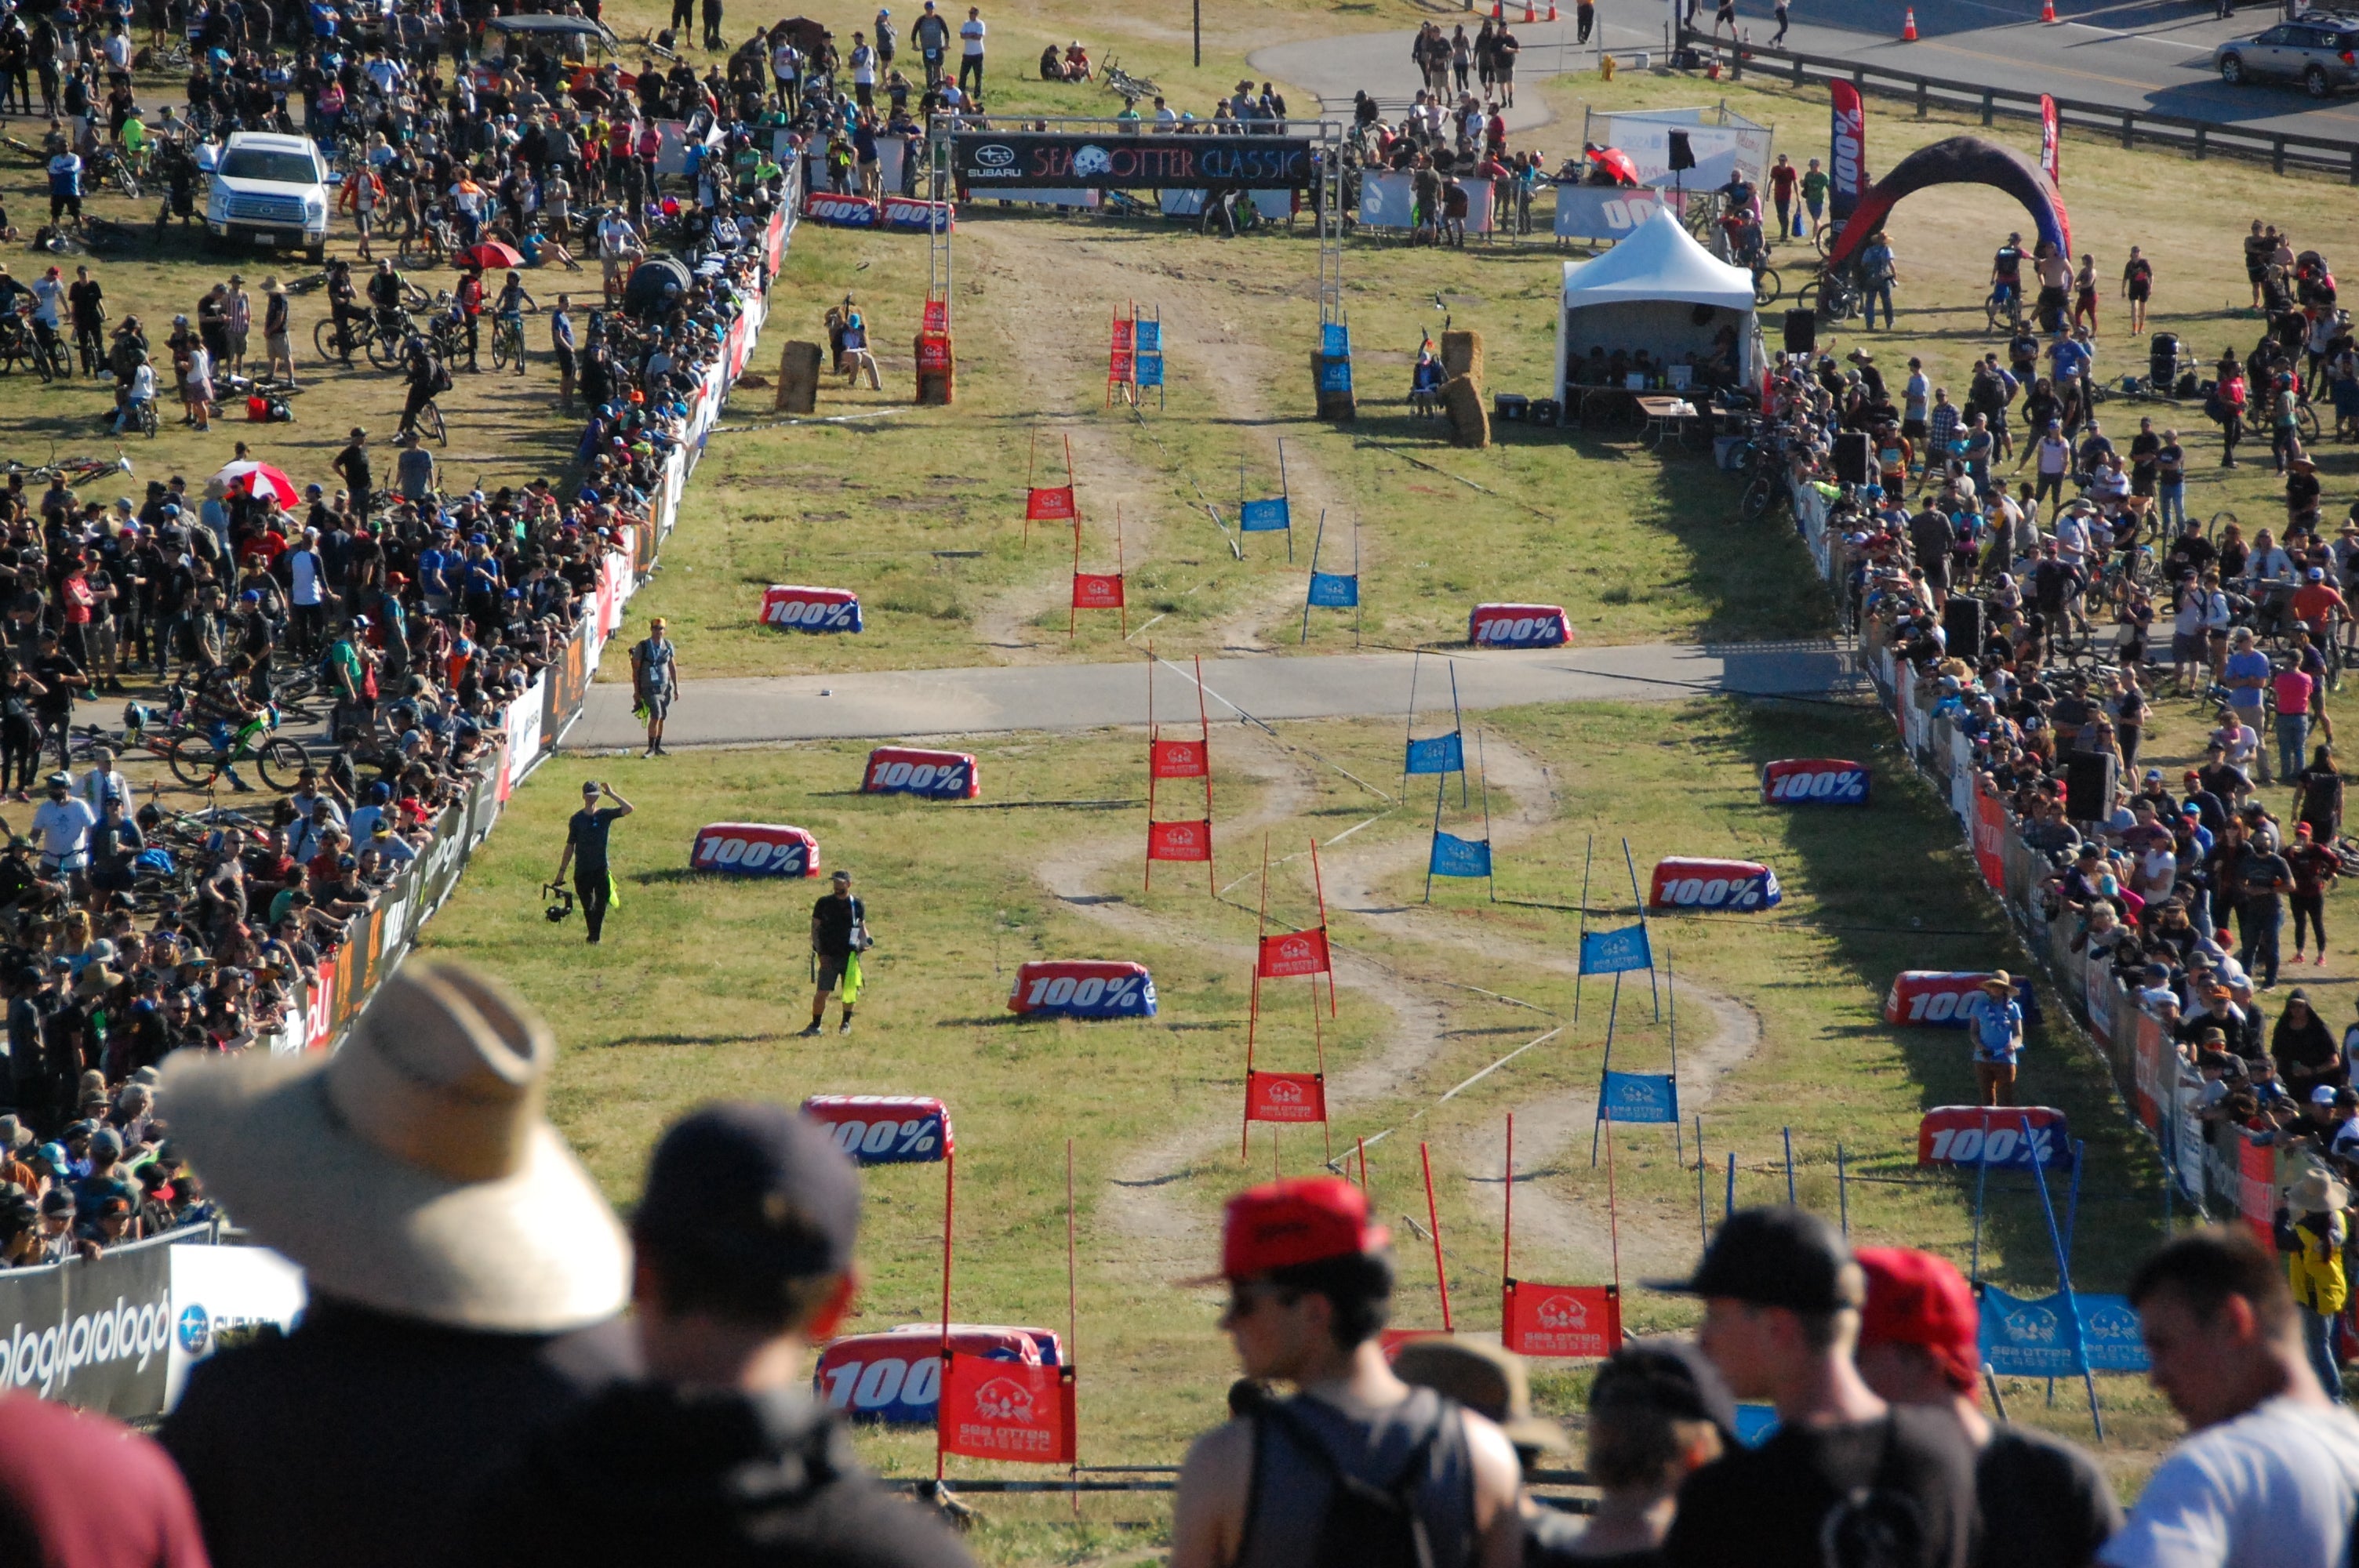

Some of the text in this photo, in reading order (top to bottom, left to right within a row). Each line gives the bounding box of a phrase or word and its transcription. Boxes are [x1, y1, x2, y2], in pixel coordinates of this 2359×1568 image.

[1031, 147, 1302, 180] SEA OTTER CLASSIC
[1834, 108, 1860, 195] 100%
[967, 169, 1022, 177] SUBARU
[808, 200, 871, 221] 100%
[885, 203, 946, 225] 100%
[767, 601, 852, 626] 100%
[1477, 616, 1558, 641] 100%
[872, 761, 965, 790] 100%
[1771, 771, 1863, 797] 100%
[700, 836, 803, 872] 100%
[1659, 877, 1760, 905] 100%
[1027, 976, 1140, 1007] 100%
[1930, 1128, 2054, 1163] 100%
[958, 1435, 1051, 1452] CLASSIC
